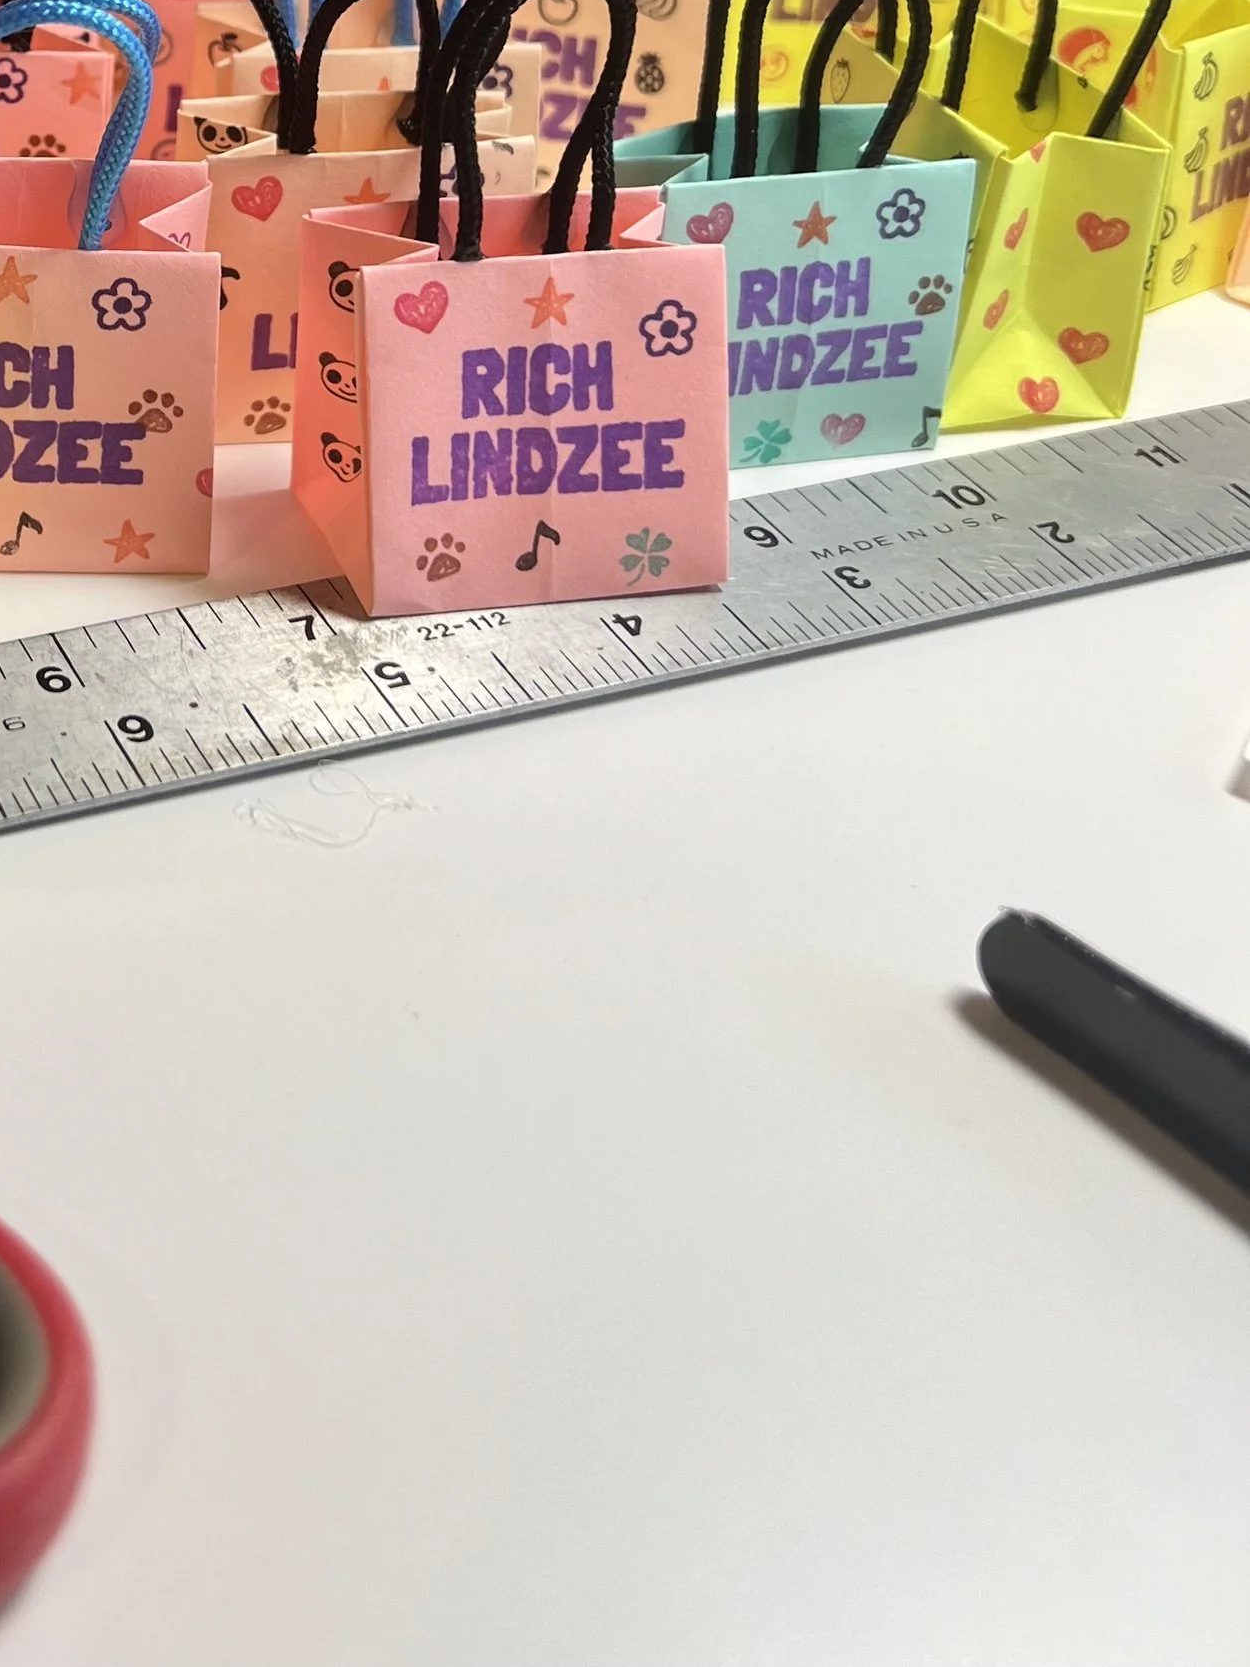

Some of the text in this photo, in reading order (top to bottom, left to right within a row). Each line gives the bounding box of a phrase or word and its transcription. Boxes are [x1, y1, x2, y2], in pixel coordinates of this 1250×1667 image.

[736, 256, 871, 330] RICH
[728, 320, 924, 398] INDZEE
[461, 340, 614, 419] RICH
[411, 418, 686, 506] LINDZEE
[1133, 445, 1180, 467] 11
[932, 484, 986, 510] 10
[743, 525, 779, 548] 9
[810, 535, 894, 560] MADE
[897, 528, 928, 542] IN
[1037, 521, 1075, 544] 2
[834, 565, 872, 589] 3
[288, 614, 316, 641] 7
[417, 611, 511, 642] 22-112
[613, 613, 643, 637] 4
[36, 666, 72, 693] 6
[375, 661, 411, 689] 5
